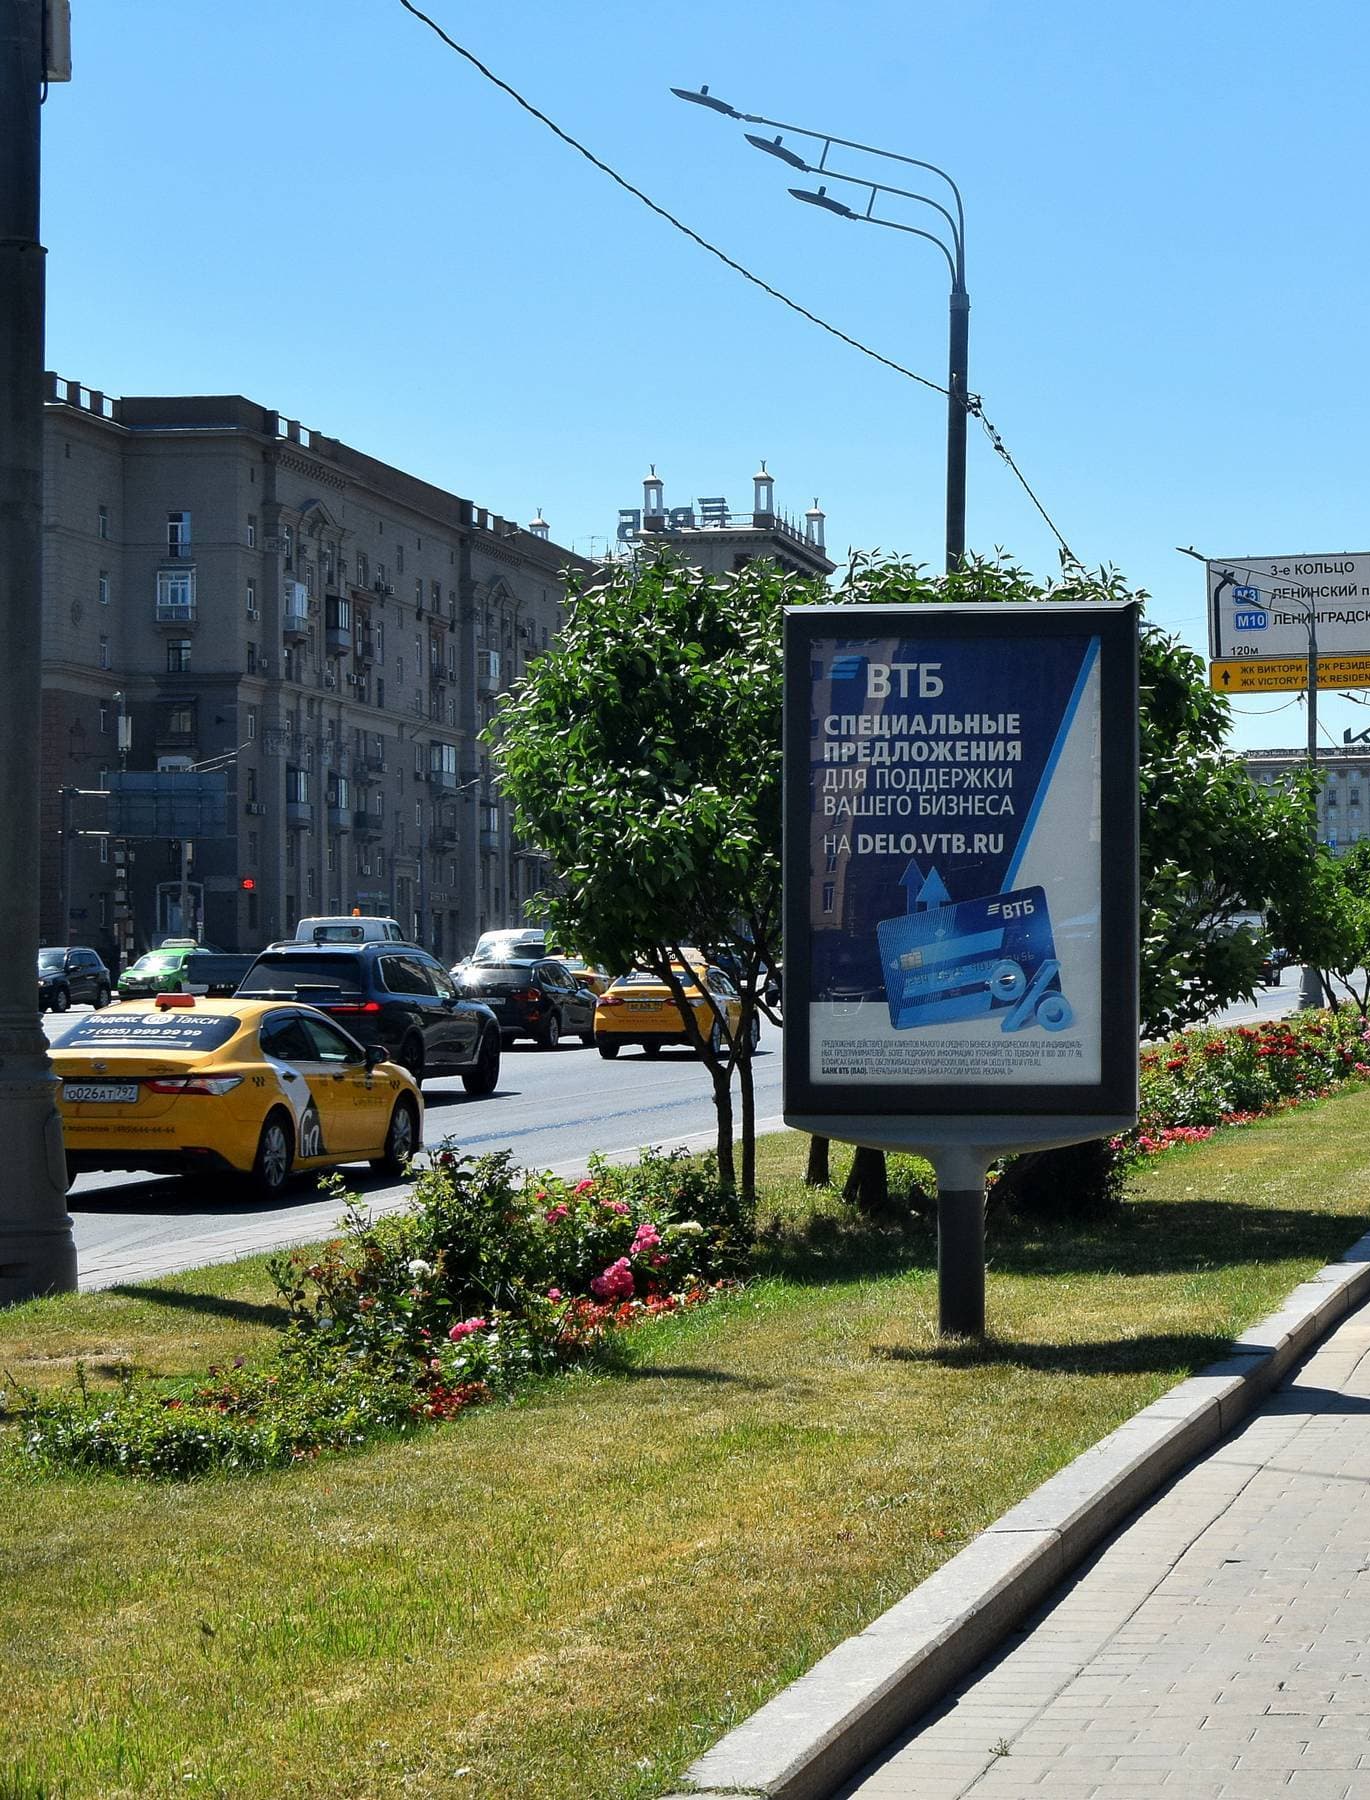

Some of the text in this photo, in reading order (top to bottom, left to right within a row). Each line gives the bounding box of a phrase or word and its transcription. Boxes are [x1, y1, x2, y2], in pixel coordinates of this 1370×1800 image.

[1270, 562, 1354, 577] 3-е КОЛЬЦО
[1273, 585, 1358, 600] ЛЕНИНСКИЙ
[1237, 614, 1265, 627] М10
[1231, 645, 1259, 656] 120м
[1240, 665, 1255, 674] ЖК
[1257, 663, 1302, 674] ВИКТОРИ
[867, 663, 944, 698] ВТБ
[1257, 676, 1298, 686] VICTORY
[1301, 674, 1327, 685] PRK
[824, 714, 1020, 738] СПЕЦИАЛЬНЫЕ
[824, 741, 1022, 765] ПРЕДЛОЖЕНИЯ
[823, 768, 1013, 792] ДЛЯ ПОДДЕРЖКИ
[824, 795, 1014, 816] ВАШЕГО БИЗНЕСА
[824, 834, 1004, 854] НА DELO.VTB.RU
[1002, 900, 1034, 919] ВТБ
[86, 1015, 142, 1024] Яндекс
[176, 1015, 220, 1025] Такси
